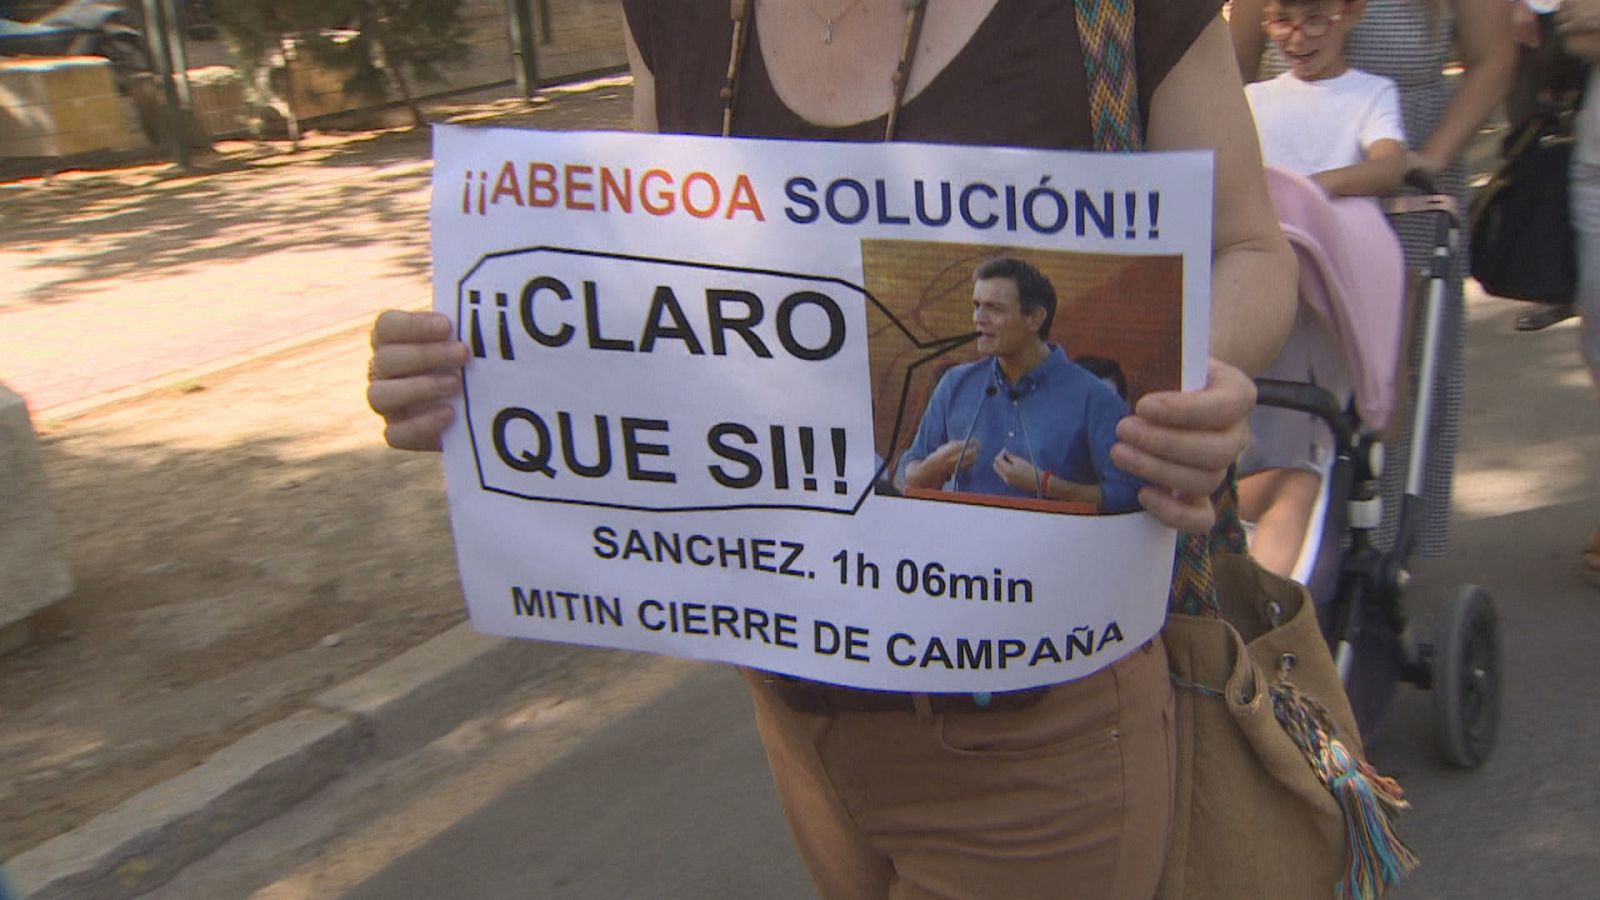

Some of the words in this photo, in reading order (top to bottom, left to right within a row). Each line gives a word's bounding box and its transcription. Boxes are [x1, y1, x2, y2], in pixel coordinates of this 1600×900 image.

[784, 175, 1162, 240] SOLUCIÓN!!
[492, 406, 677, 483] QUE
[707, 422, 849, 496] SI!!
[593, 526, 815, 580] SANCHEZ.
[832, 550, 880, 590] 1h
[895, 559, 1034, 604] 06min
[512, 586, 623, 627] MITIN
[638, 600, 799, 649] CIERRE
[813, 620, 870, 662] DE
[886, 620, 1124, 670] CAMPAÑA
